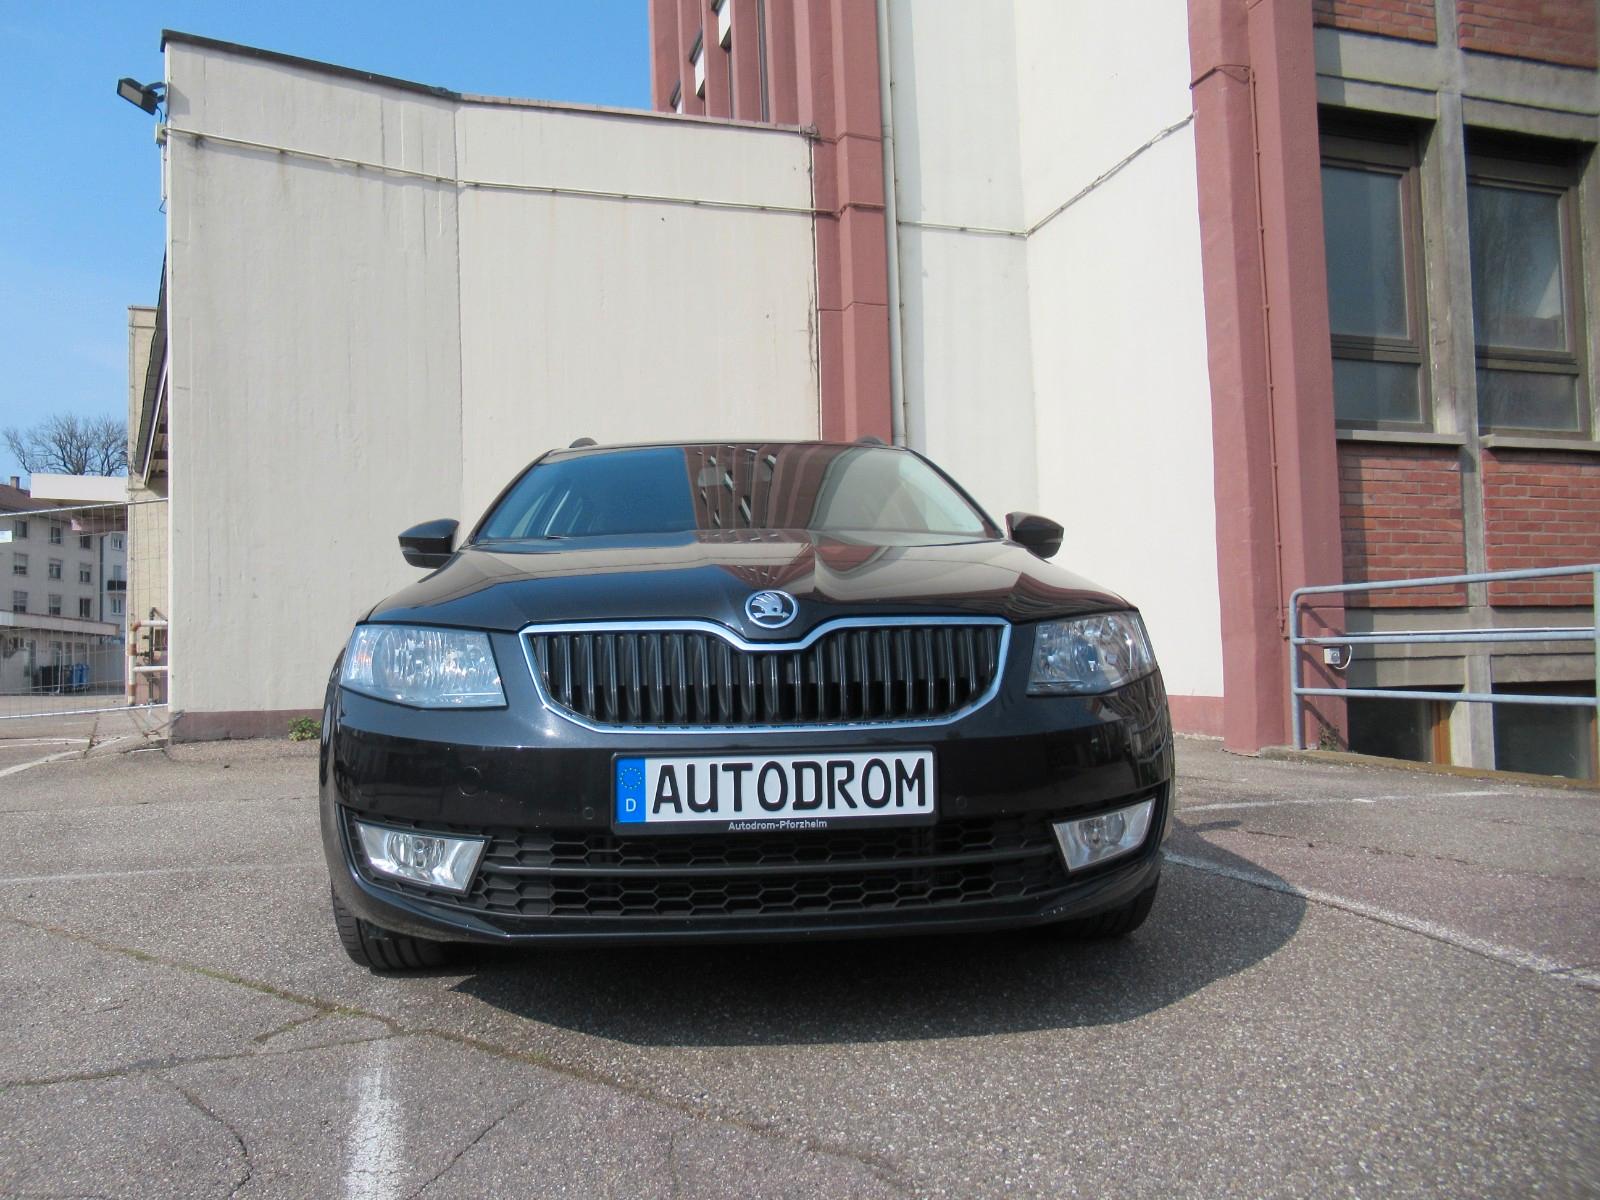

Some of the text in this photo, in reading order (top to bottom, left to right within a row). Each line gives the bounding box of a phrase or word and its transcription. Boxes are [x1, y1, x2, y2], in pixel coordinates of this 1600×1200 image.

[652, 758, 926, 813] AUTODROM
[625, 798, 637, 812] D
[728, 819, 828, 831] Autodrom-Pforzheim
